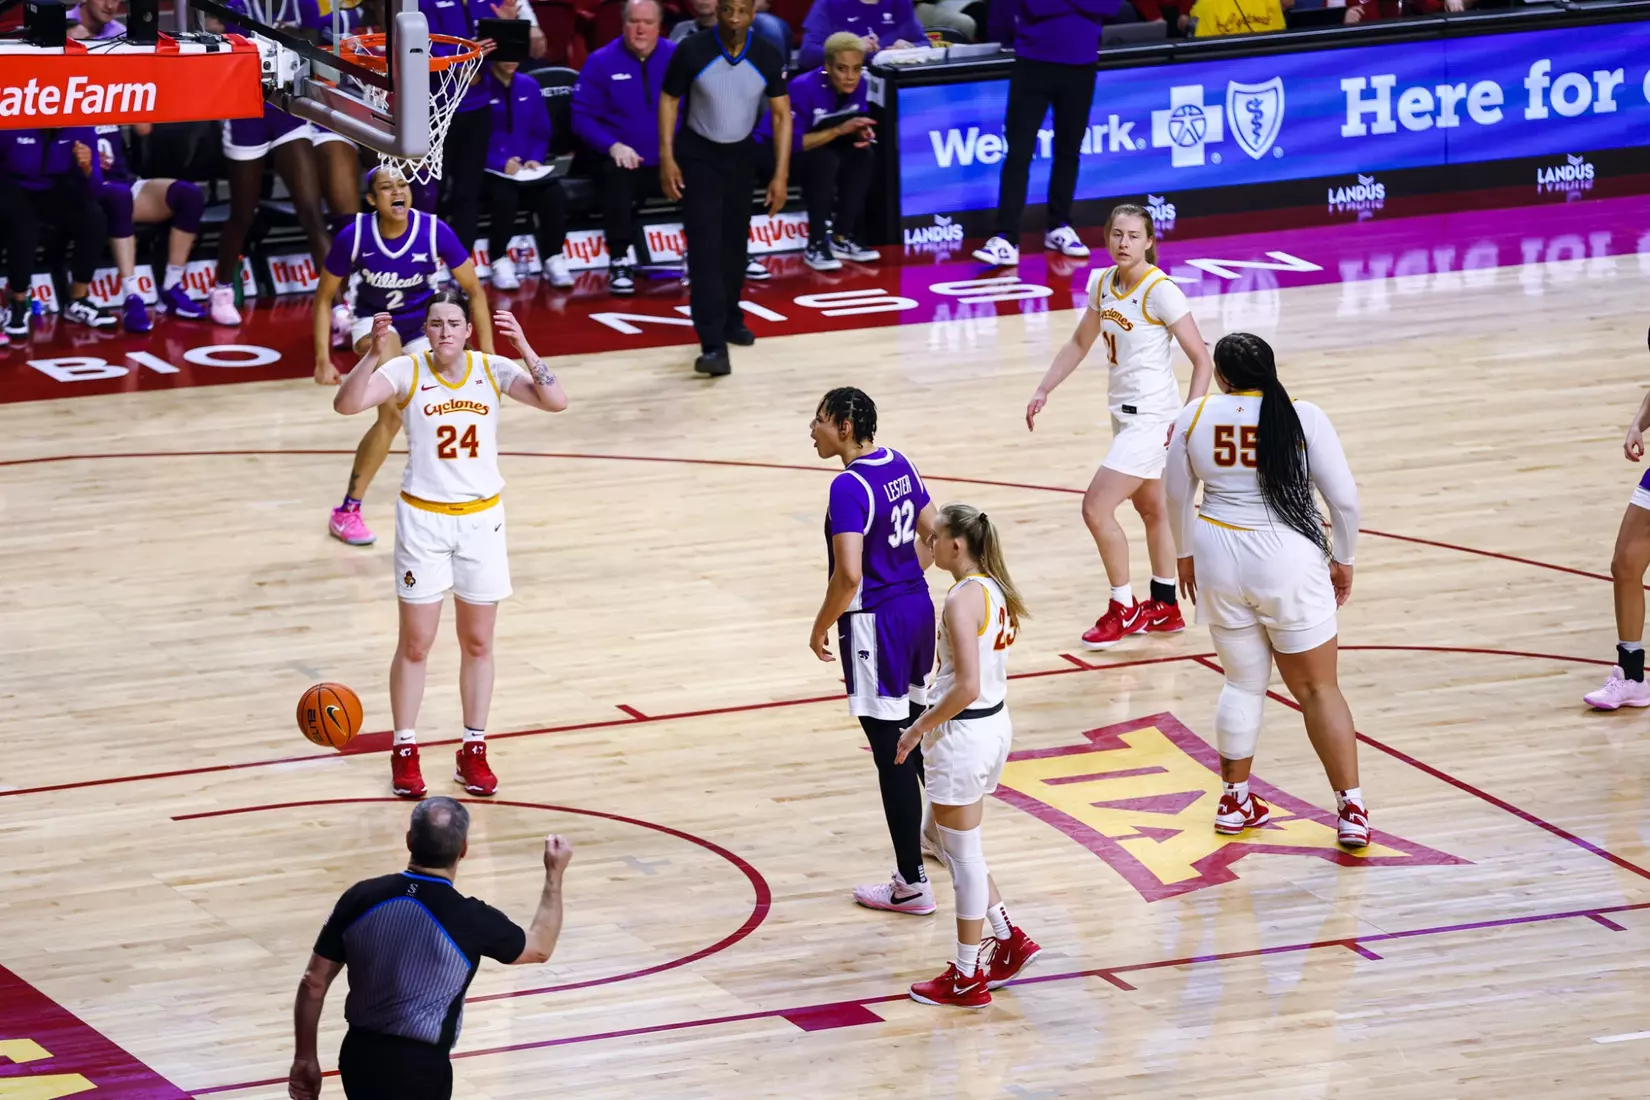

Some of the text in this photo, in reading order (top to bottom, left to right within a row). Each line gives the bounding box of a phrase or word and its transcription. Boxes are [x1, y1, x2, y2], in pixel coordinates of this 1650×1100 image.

[1340, 74, 1505, 138] Here
[1524, 59, 1625, 121] for
[1537, 163, 1595, 184] LANDUS
[1328, 183, 1386, 205] LANDUS
[1143, 203, 1176, 221] DUS
[904, 223, 964, 244] LANDUS
[361, 268, 424, 289] Wildcats
[385, 290, 405, 310] 2
[1101, 307, 1134, 332] yclones
[423, 398, 490, 416] Cyclones
[436, 424, 479, 460] 24
[1213, 424, 1258, 469] 55
[883, 474, 912, 503] LESTER
[888, 498, 915, 549] 32
